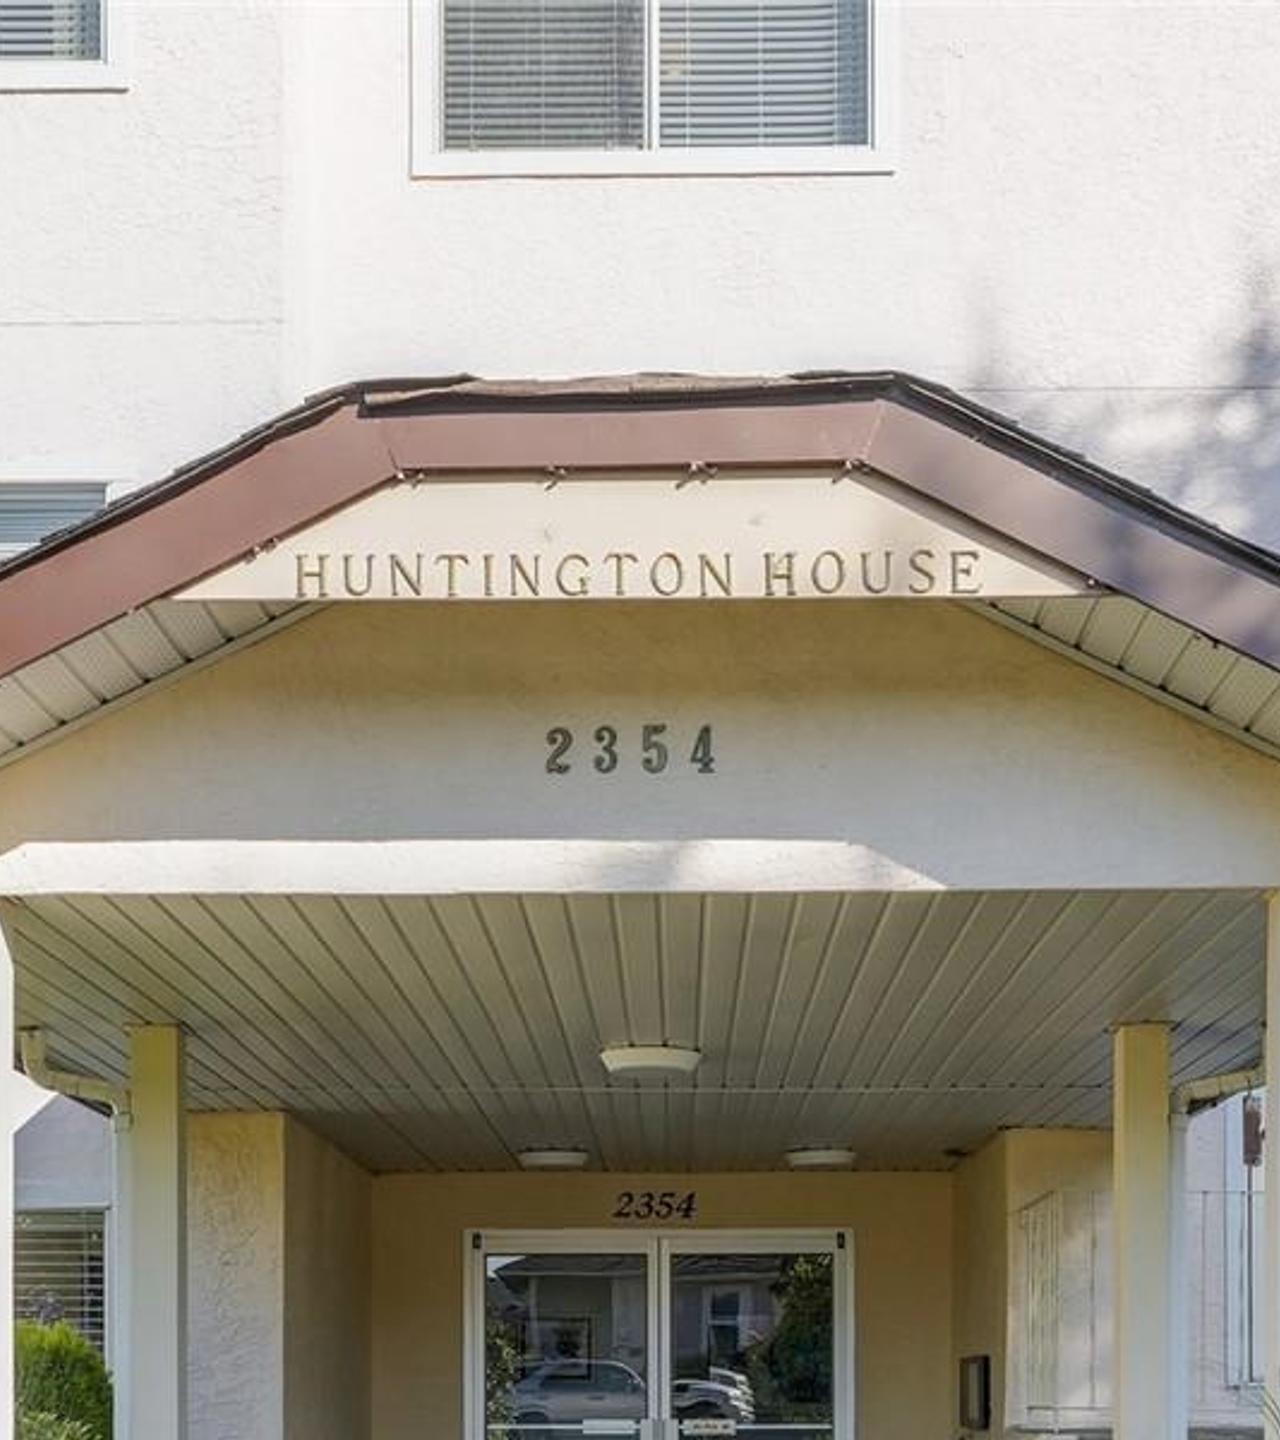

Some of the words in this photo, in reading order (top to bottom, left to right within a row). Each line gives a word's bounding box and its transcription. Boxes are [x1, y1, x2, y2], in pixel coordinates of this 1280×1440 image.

[294, 551, 733, 598] HUNTINGTON
[763, 549, 984, 597] HOUSE
[545, 722, 717, 775] 2354
[611, 1191, 698, 1220] 2354
